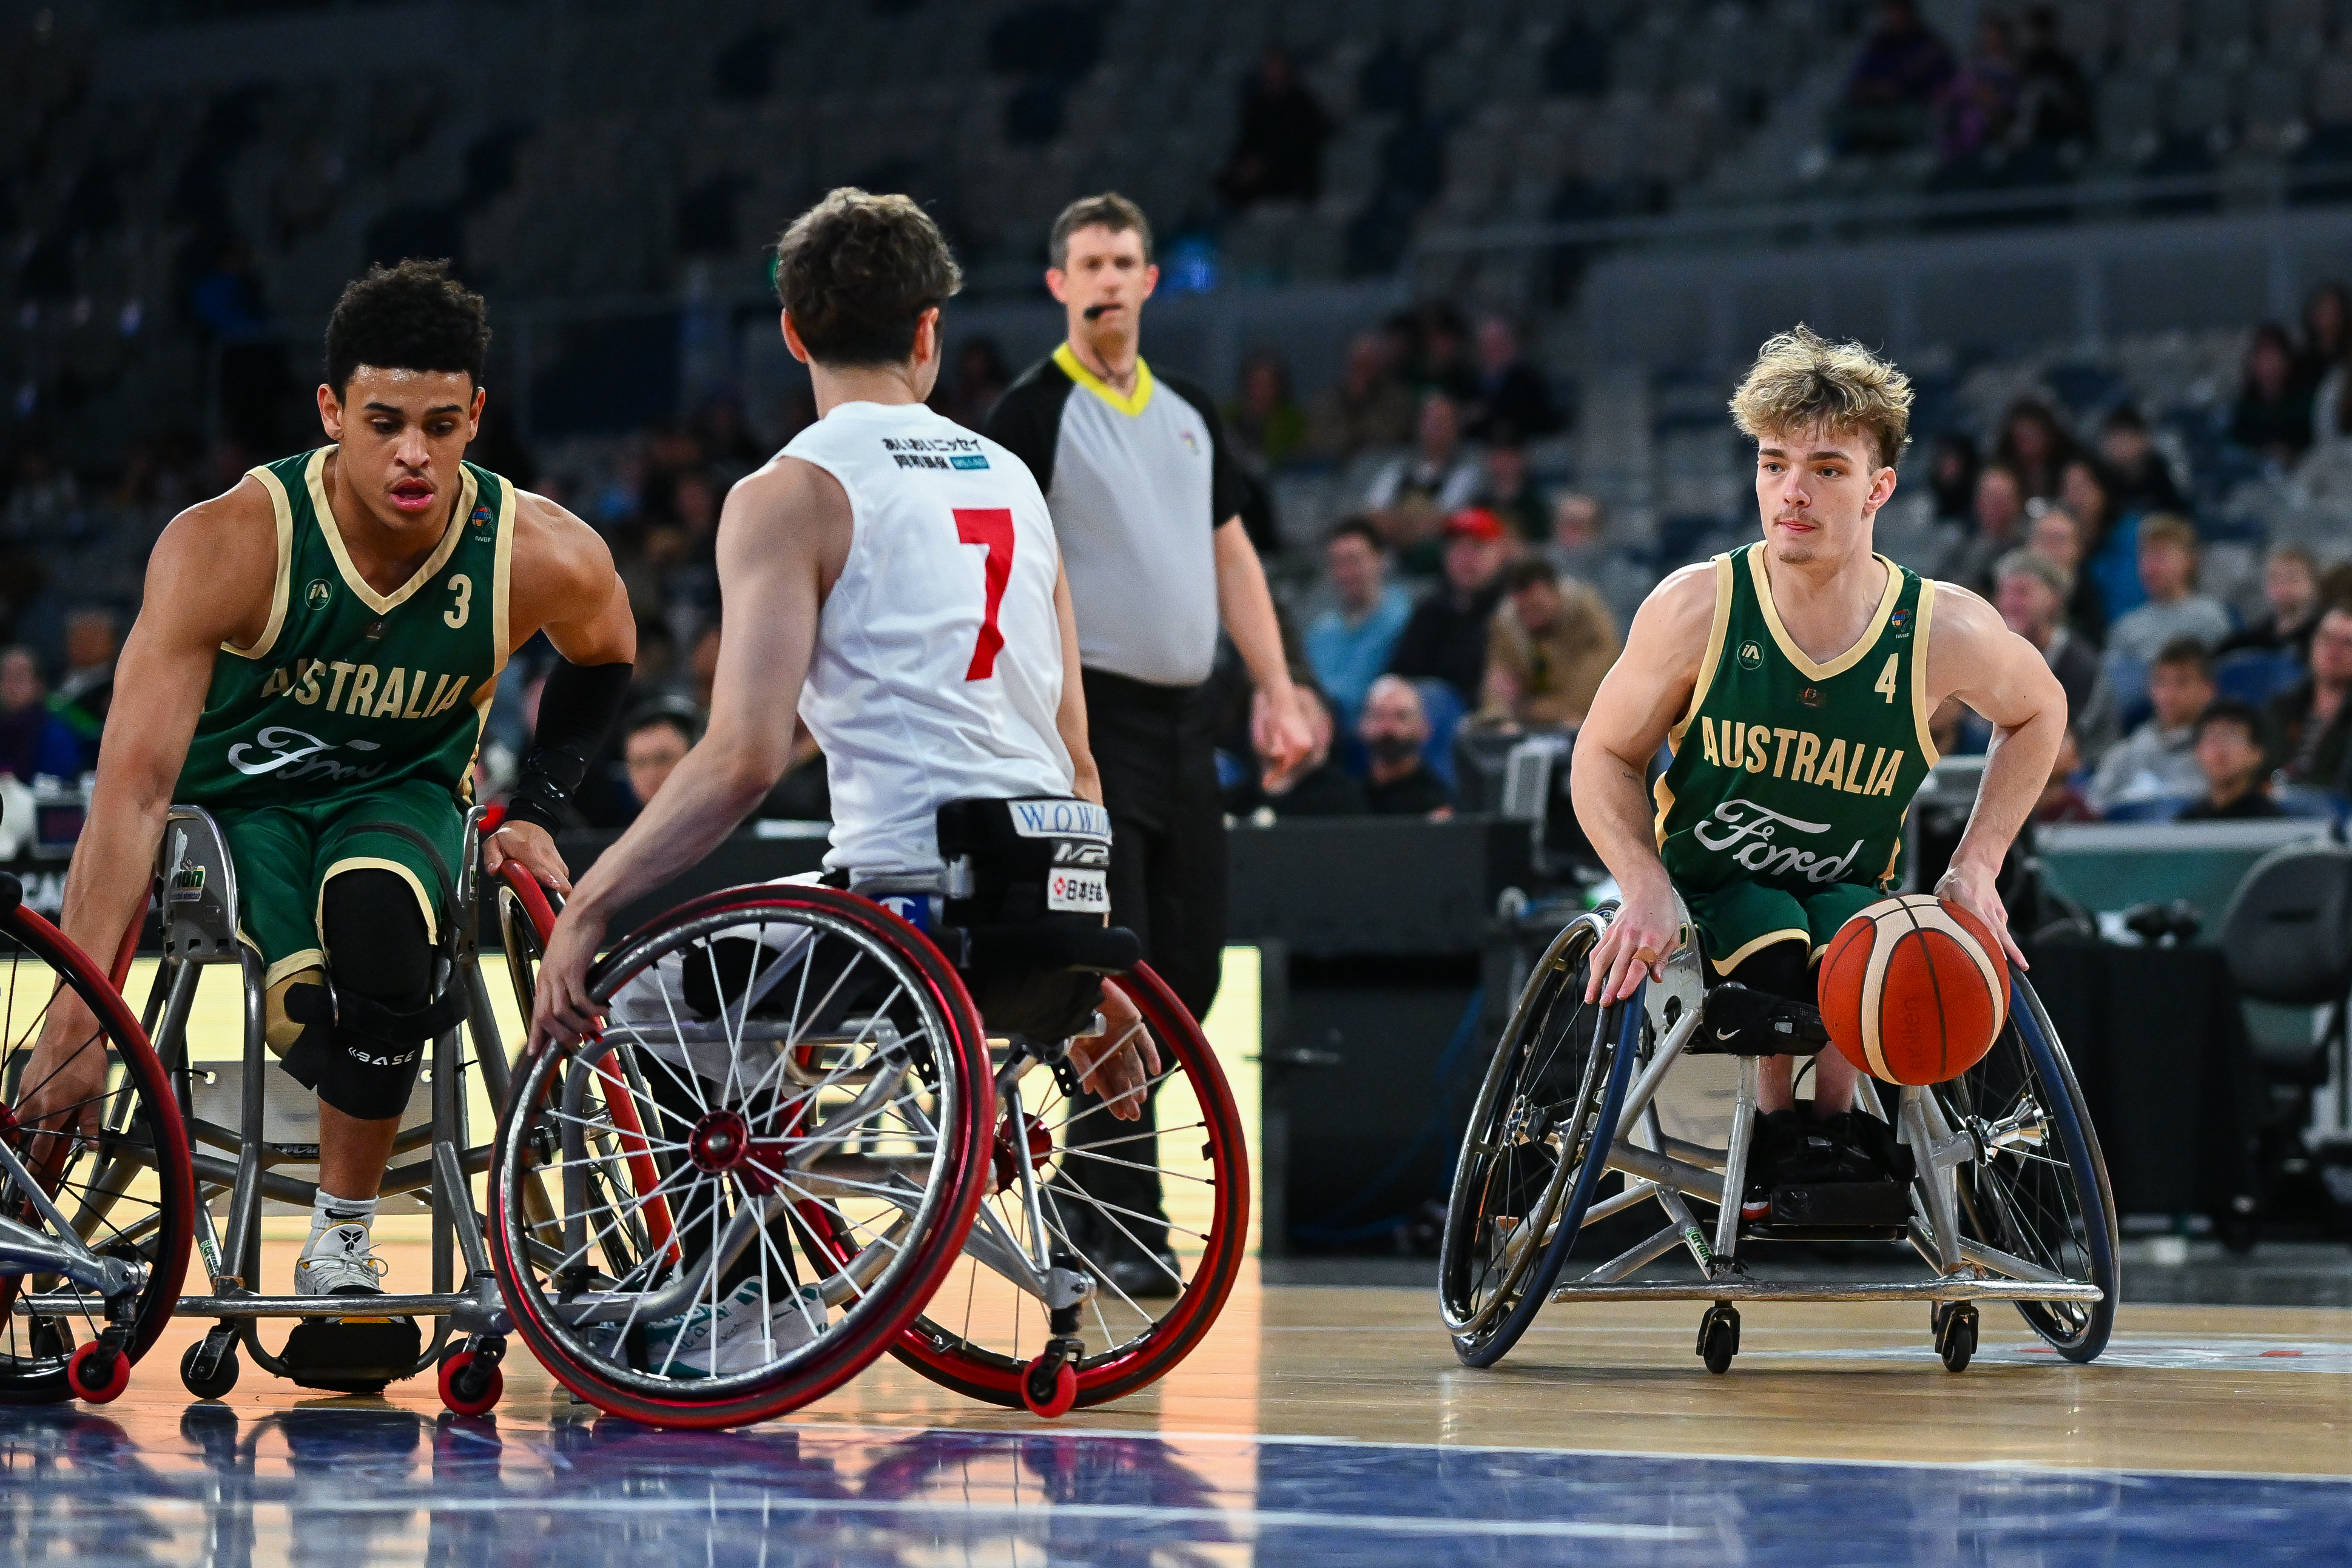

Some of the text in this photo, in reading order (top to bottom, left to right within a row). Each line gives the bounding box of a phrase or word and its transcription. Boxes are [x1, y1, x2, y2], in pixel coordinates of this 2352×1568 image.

[444, 573, 473, 629] 3
[952, 508, 1015, 682] 7
[1874, 653, 1899, 704] 4
[1701, 716, 1904, 796] AUSTRALIA
[1694, 799, 1864, 883] Ford
